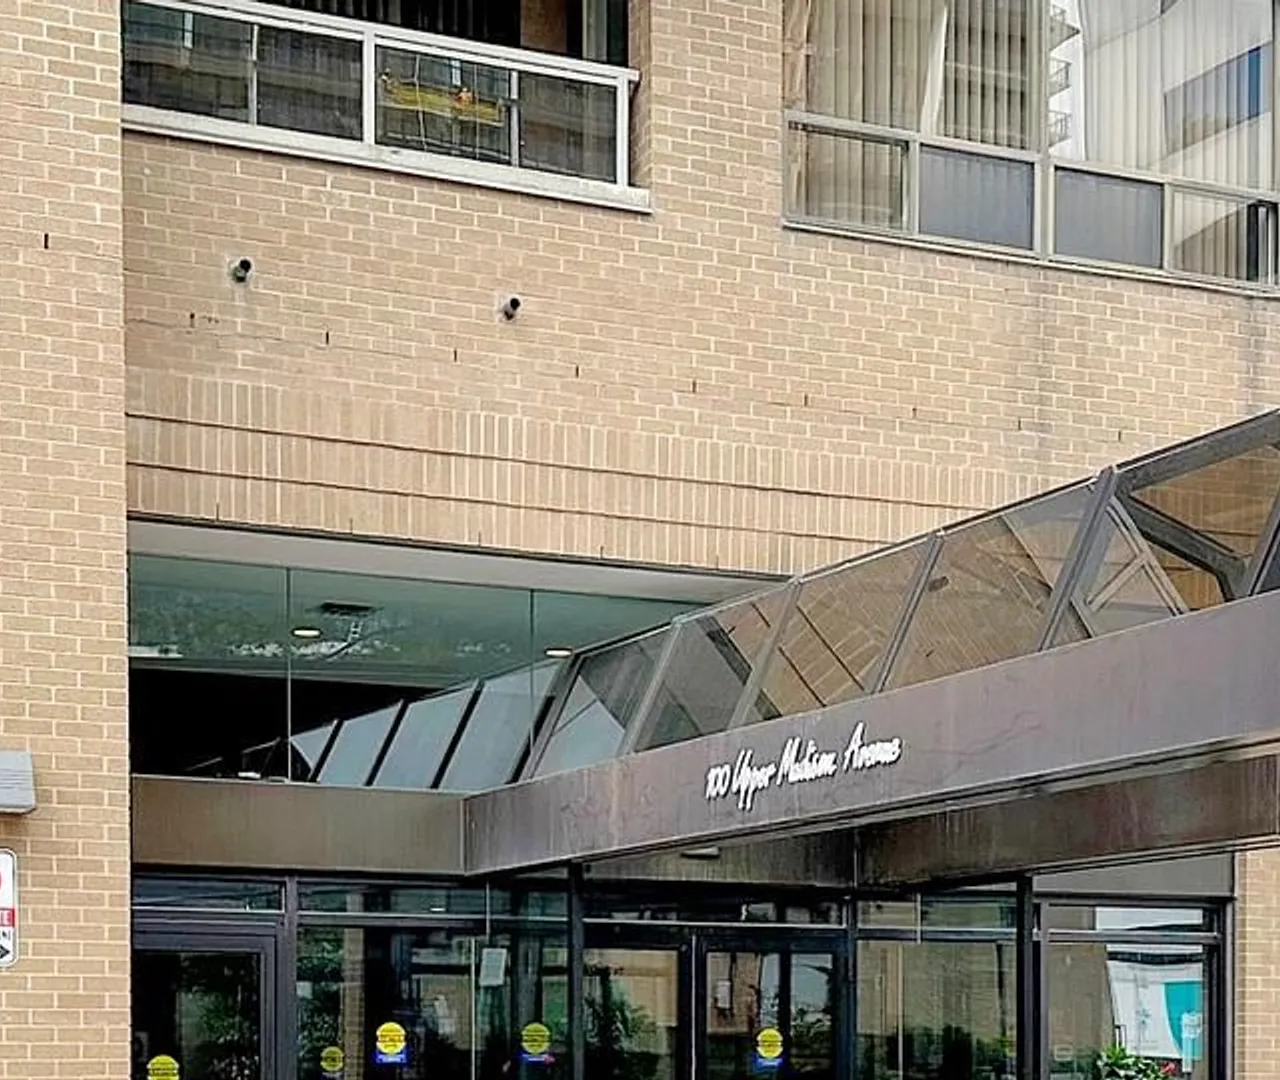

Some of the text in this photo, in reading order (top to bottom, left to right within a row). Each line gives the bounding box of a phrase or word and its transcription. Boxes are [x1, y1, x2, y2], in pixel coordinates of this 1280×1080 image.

[705, 722, 902, 810] 100 Upper Madison Avenue
